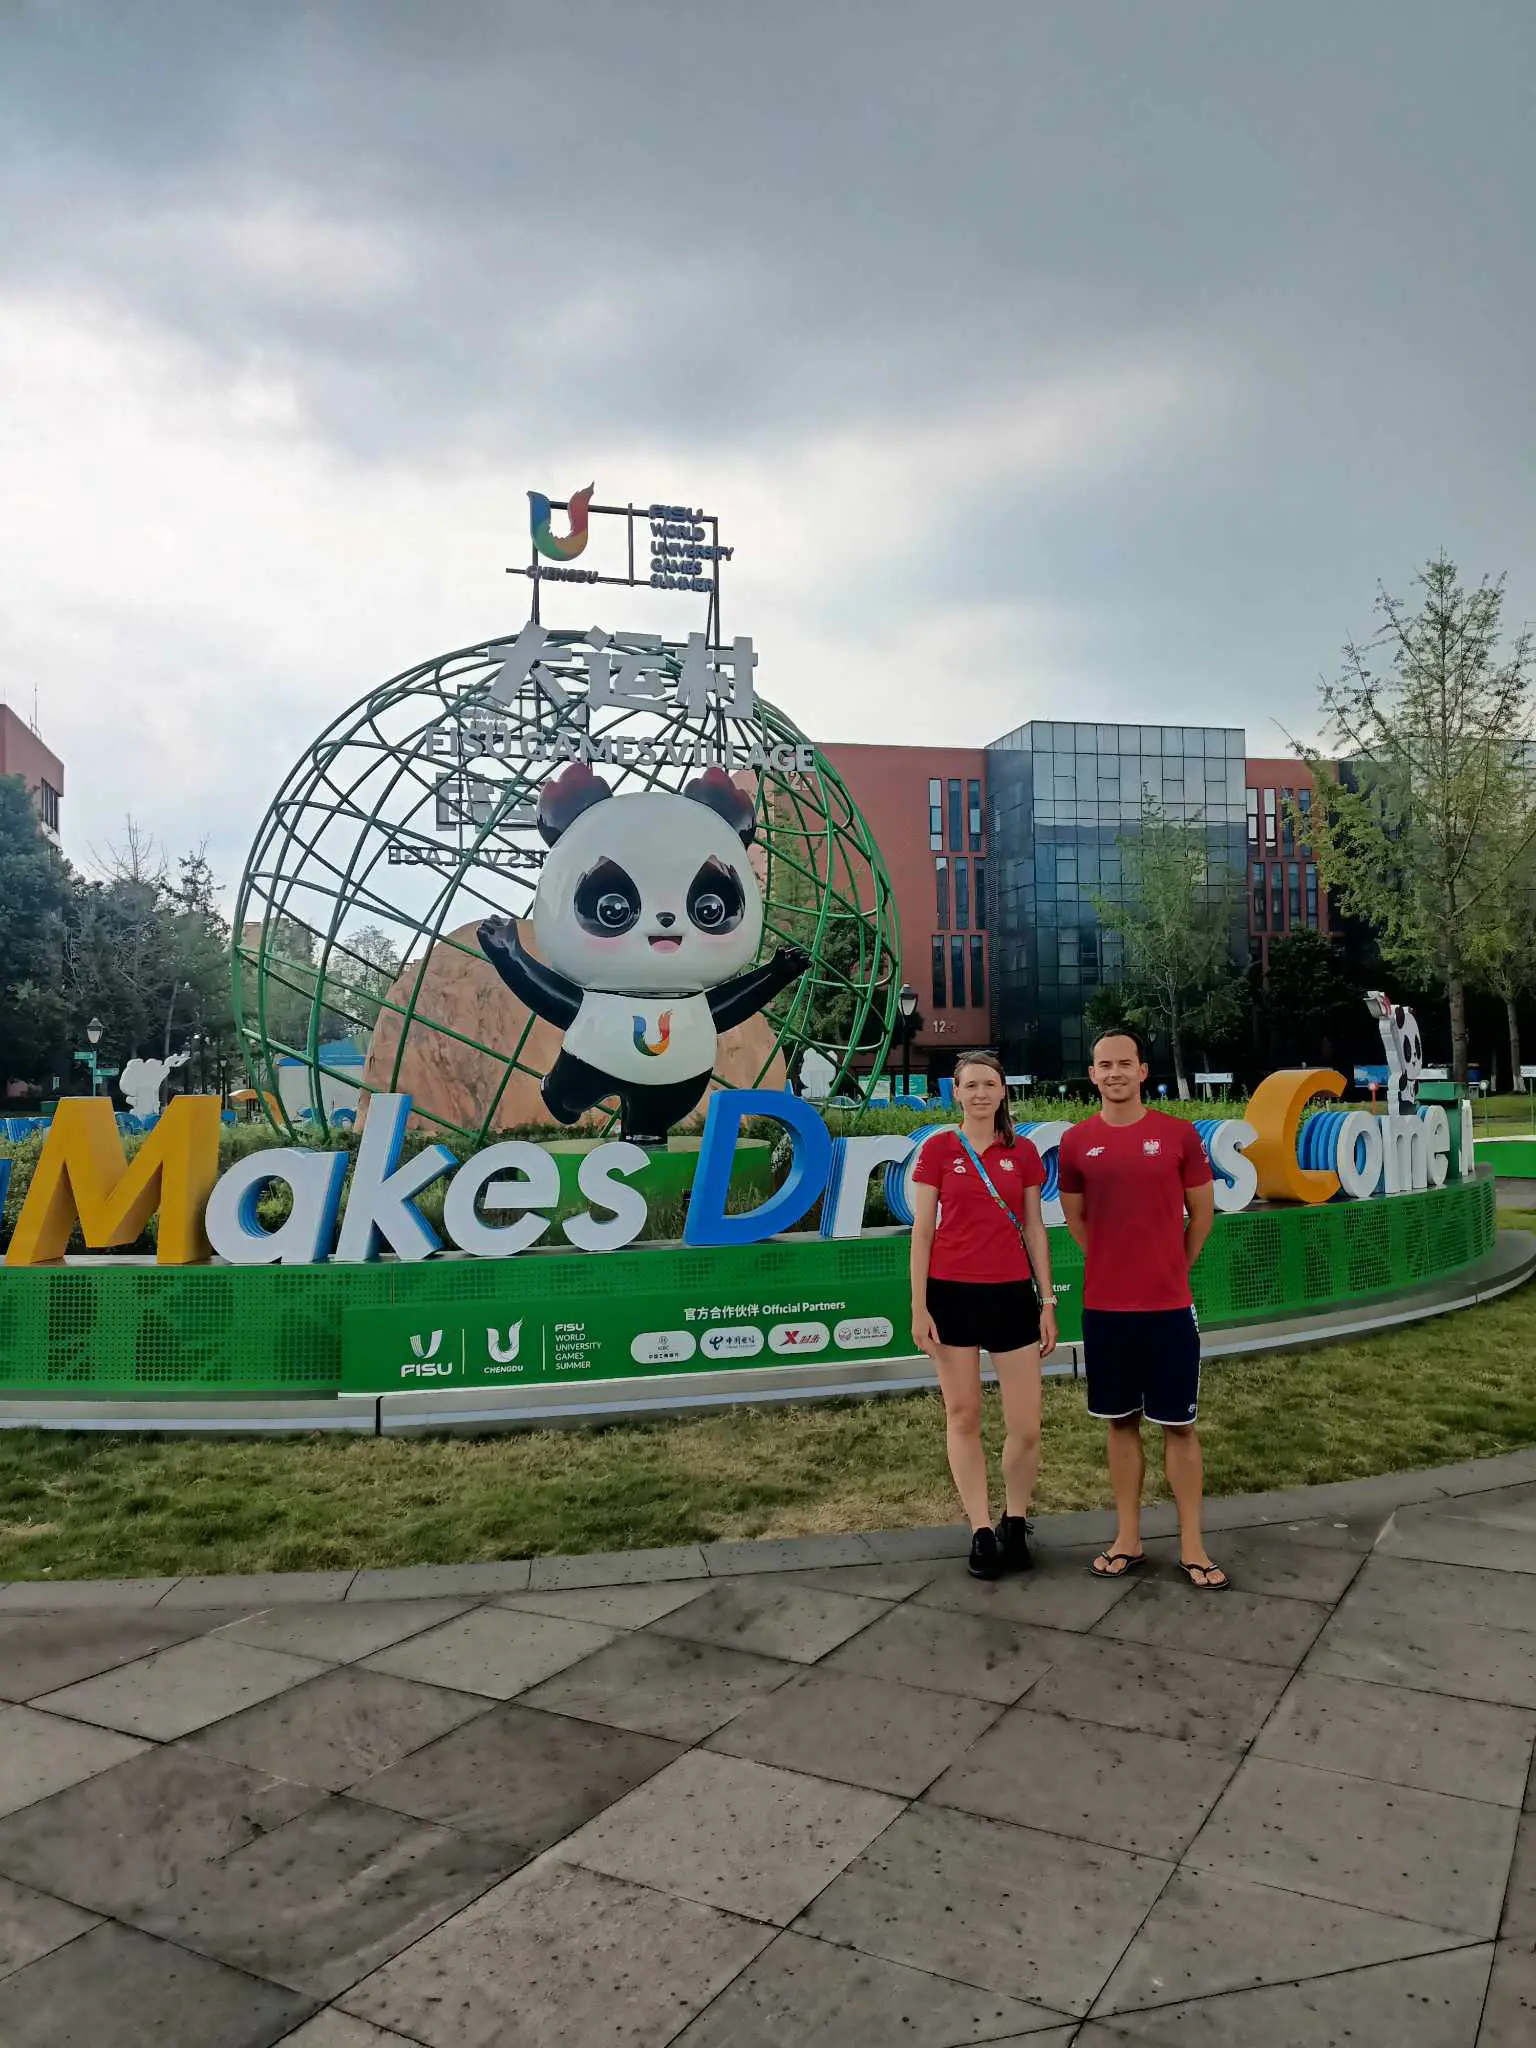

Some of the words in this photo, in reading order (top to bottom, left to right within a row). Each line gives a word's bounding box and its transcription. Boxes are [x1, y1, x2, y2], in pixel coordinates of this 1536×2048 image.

[650, 522, 706, 542] WORLD
[650, 541, 734, 561] UNIVERSITY
[525, 564, 599, 585] CHENGDU
[650, 558, 703, 576] GAMES
[650, 574, 715, 593] SUMMER
[487, 620, 759, 719] 大运村
[425, 726, 512, 759] FISU
[520, 731, 657, 766] GAMES
[663, 737, 818, 773] VILLAGE
[5, 1094, 651, 1266] Makes
[685, 1088, 1259, 1247] Drs
[1243, 1069, 1451, 1204] Come
[683, 1303, 760, 1321] 官方合作伙伴
[762, 1303, 801, 1315] Official
[802, 1301, 846, 1312] Partners
[554, 1323, 585, 1332] FISU
[555, 1333, 586, 1342] WORLD
[555, 1342, 602, 1351] UNIVERSITY
[555, 1352, 585, 1361] GAMES
[400, 1362, 453, 1378] FISU
[483, 1365, 524, 1374] CHENGDU
[555, 1361, 592, 1371] SUMMER
